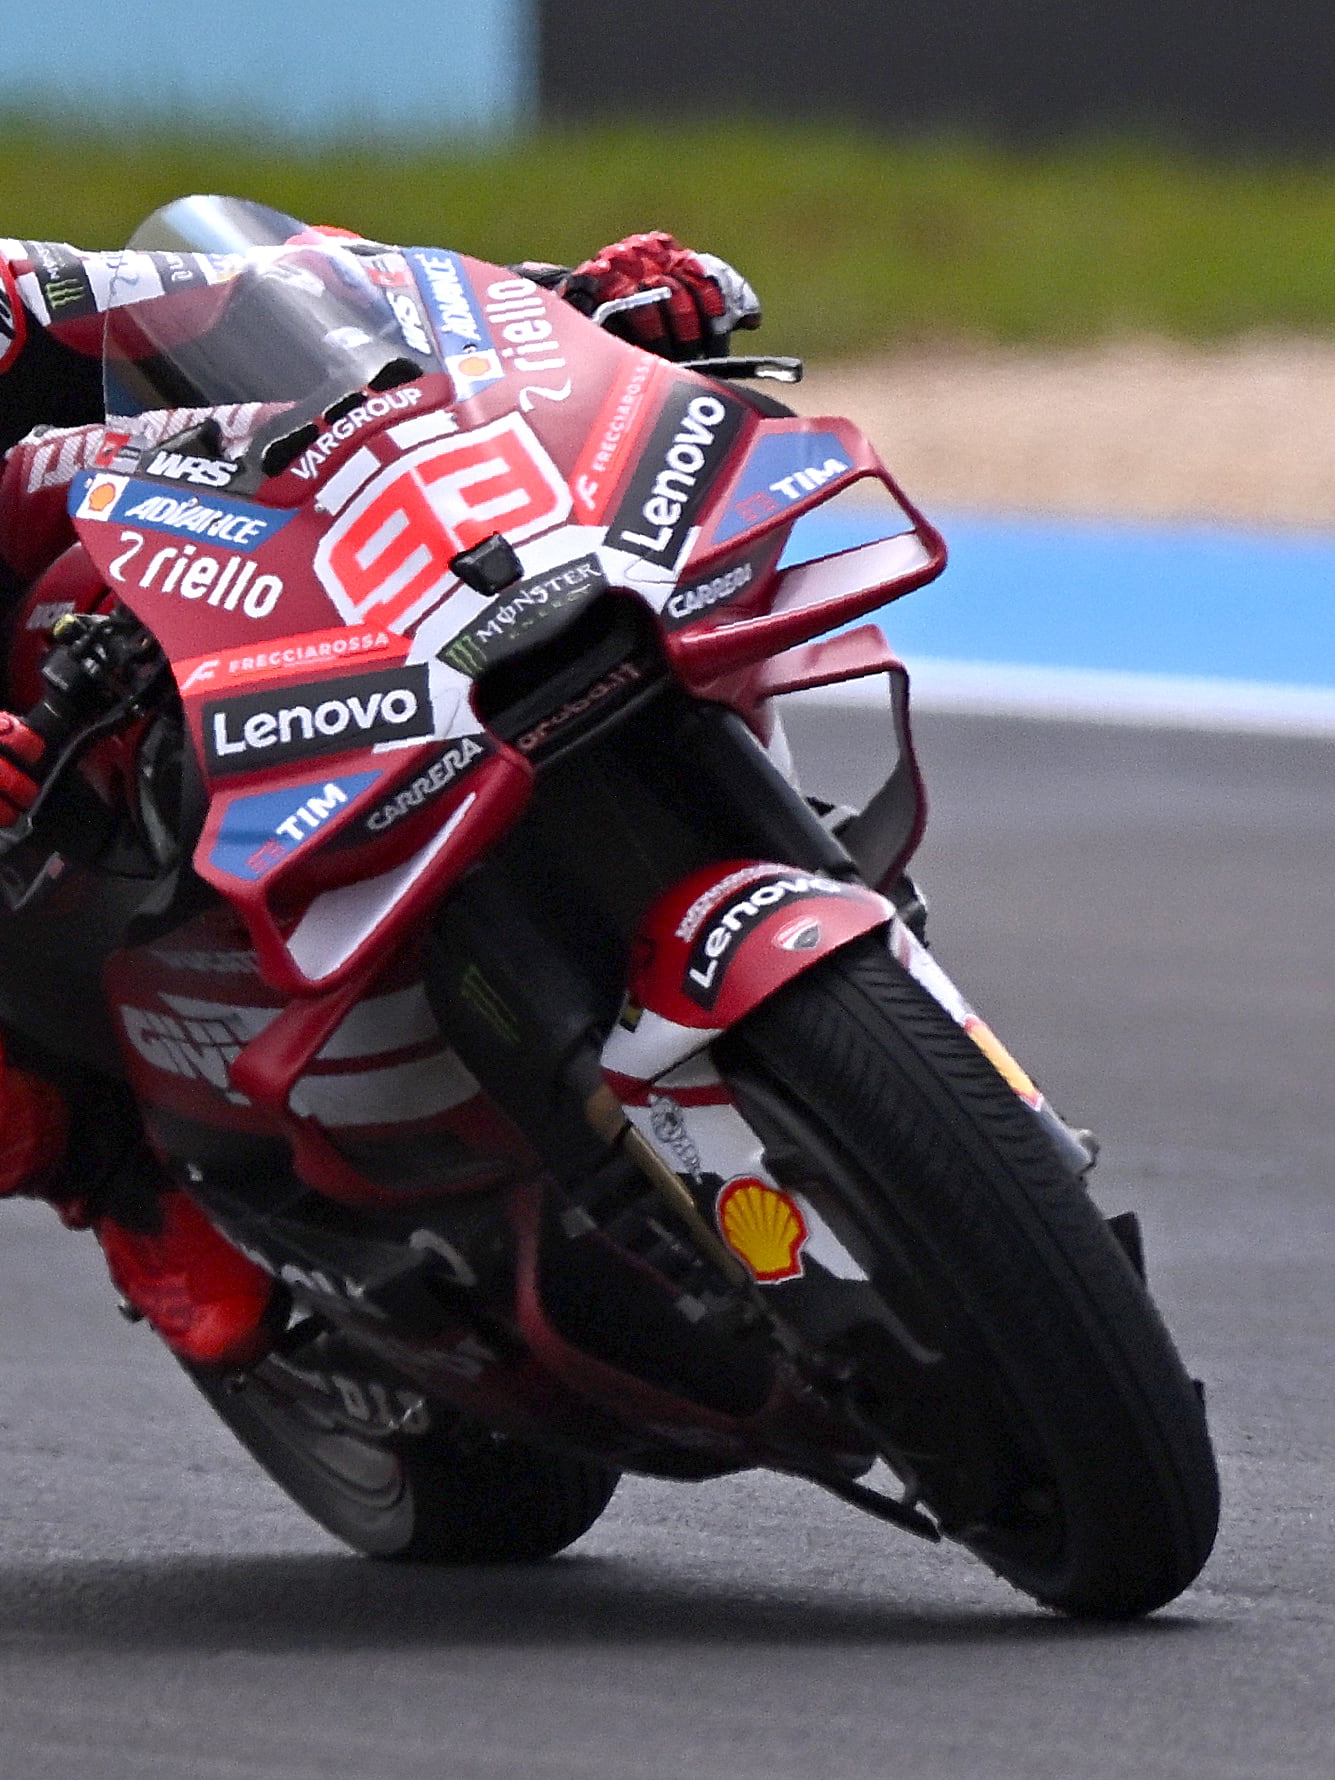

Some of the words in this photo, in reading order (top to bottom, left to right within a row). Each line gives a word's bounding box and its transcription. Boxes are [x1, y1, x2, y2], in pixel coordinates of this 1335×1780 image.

[485, 277, 567, 372] riello
[145, 449, 239, 488] WRS
[289, 386, 424, 481] VARGROUP
[620, 395, 726, 552] Lenovo
[769, 457, 850, 500] TIM
[124, 495, 268, 545] ADVANCE
[319, 420, 567, 628] 93
[137, 544, 284, 619] riello
[227, 631, 391, 674] FRECCIAROSSA
[213, 688, 418, 757] Lenovo
[275, 782, 349, 841] TIM
[366, 737, 484, 832] CARRERA
[688, 877, 842, 990] Lenovo
